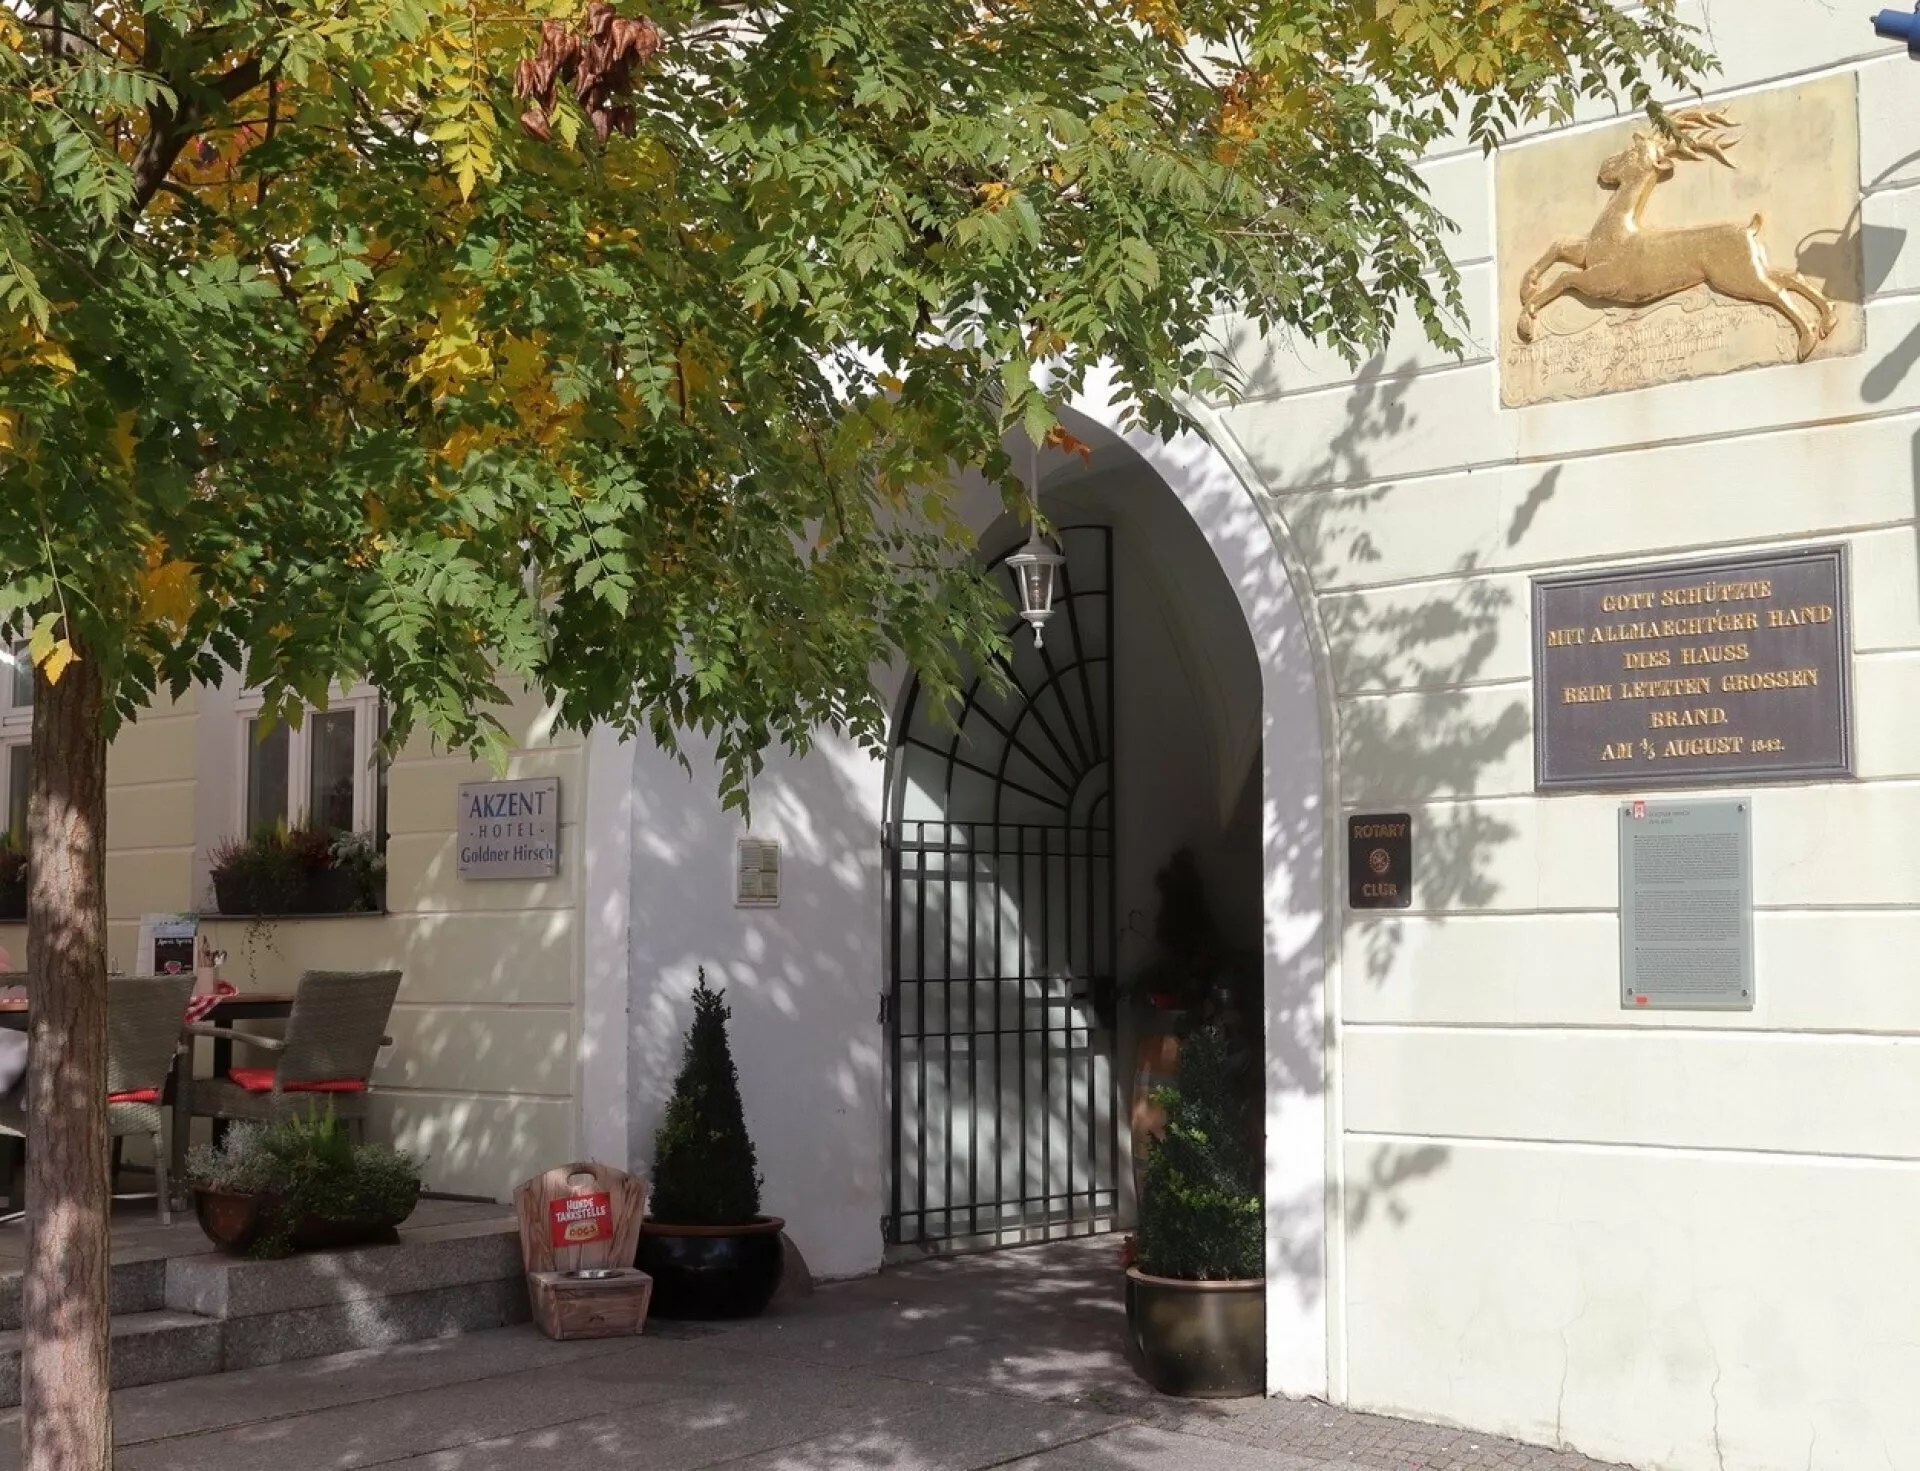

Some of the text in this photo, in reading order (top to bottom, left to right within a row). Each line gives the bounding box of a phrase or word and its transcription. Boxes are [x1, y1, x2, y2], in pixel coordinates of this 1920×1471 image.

[1602, 580, 1771, 612] GOTT SCHÜTZTE
[1547, 627, 1584, 647] MIT
[1766, 604, 1833, 628] HAND
[1622, 643, 1749, 670] DIES HAUSS
[1561, 667, 1818, 704] BEIM LETZTEN GROSSEN
[1648, 707, 1728, 729] BRAND.
[1600, 742, 1633, 761] AM
[1661, 736, 1743, 758] AUGUST
[469, 791, 546, 818] AKZENT
[479, 823, 534, 838] HOTEL
[1354, 824, 1405, 839] ROTARY
[461, 843, 553, 863] Goldner Hirsch
[1363, 883, 1398, 897] CLUB
[556, 1205, 606, 1222] TANKSTELLE
[566, 1198, 594, 1210] HUNDE
